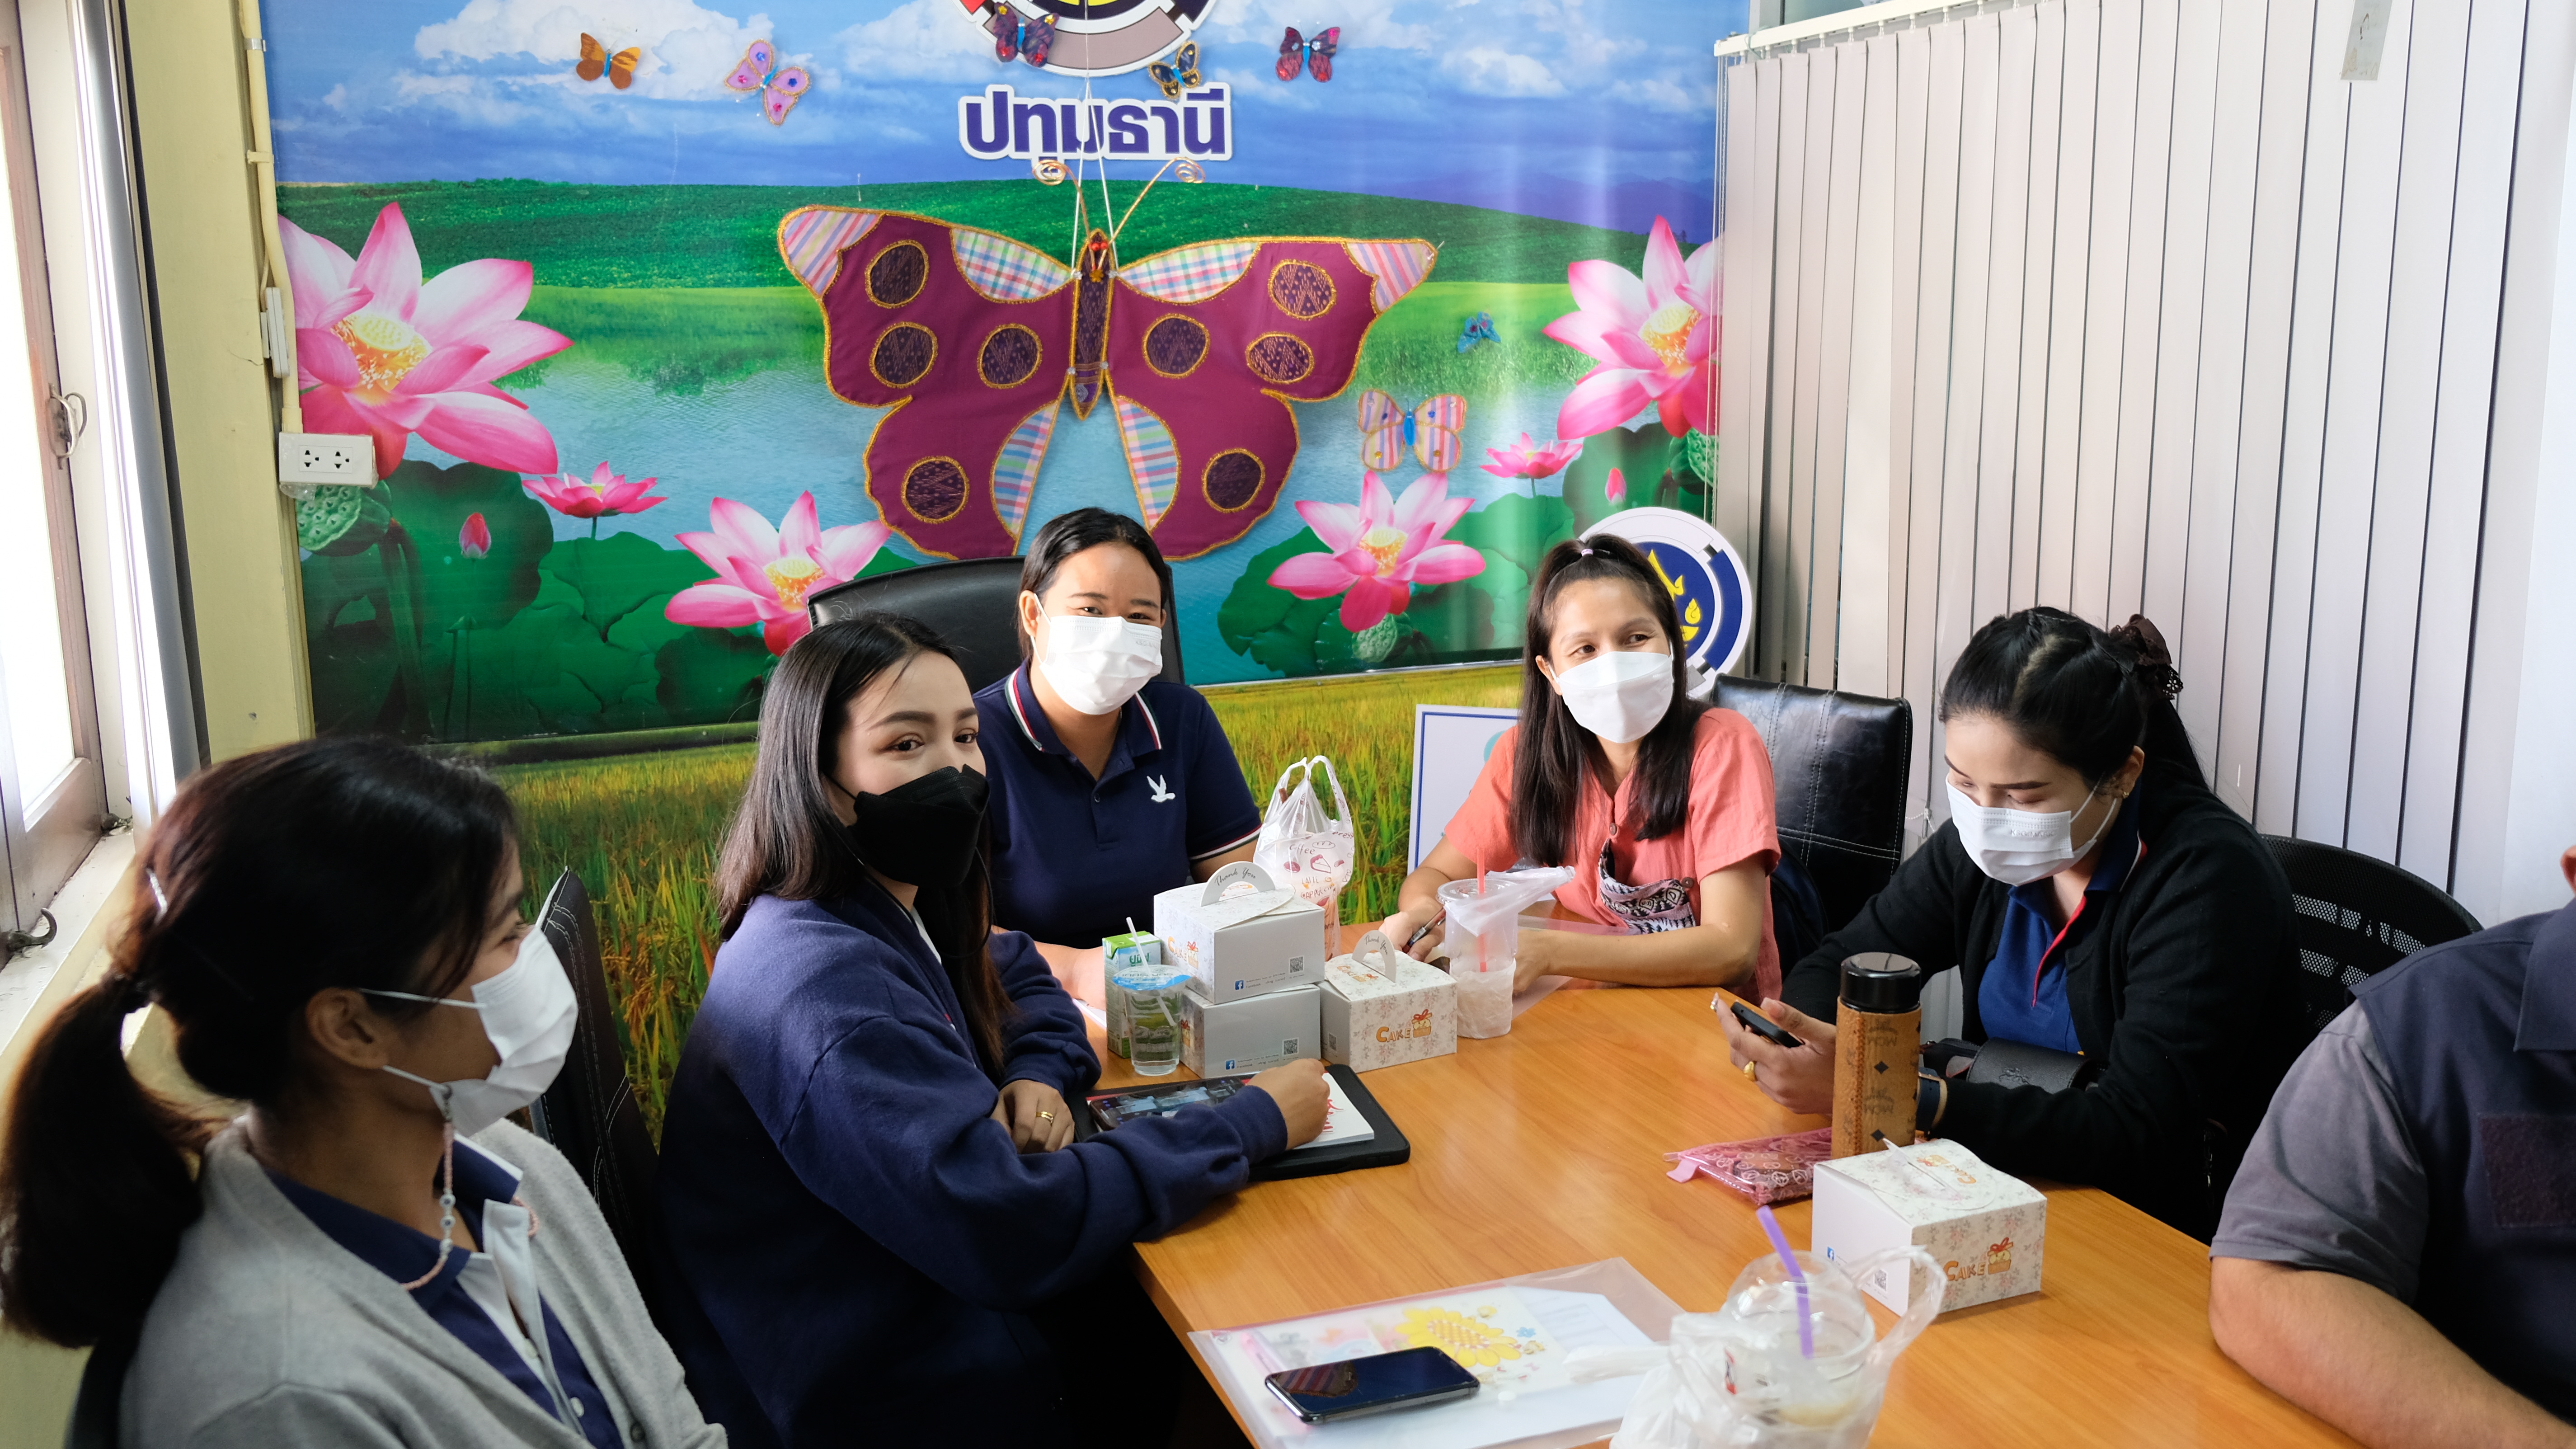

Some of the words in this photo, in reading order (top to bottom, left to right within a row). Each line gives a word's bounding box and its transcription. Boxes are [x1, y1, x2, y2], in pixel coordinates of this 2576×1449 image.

[966, 88, 1225, 173] ปทุมธานี
[1214, 867, 1238, 886] Thank
[1242, 867, 1256, 879] You
[1376, 1026, 1410, 1042] CAKE
[1943, 1260, 1986, 1281] CAKE
